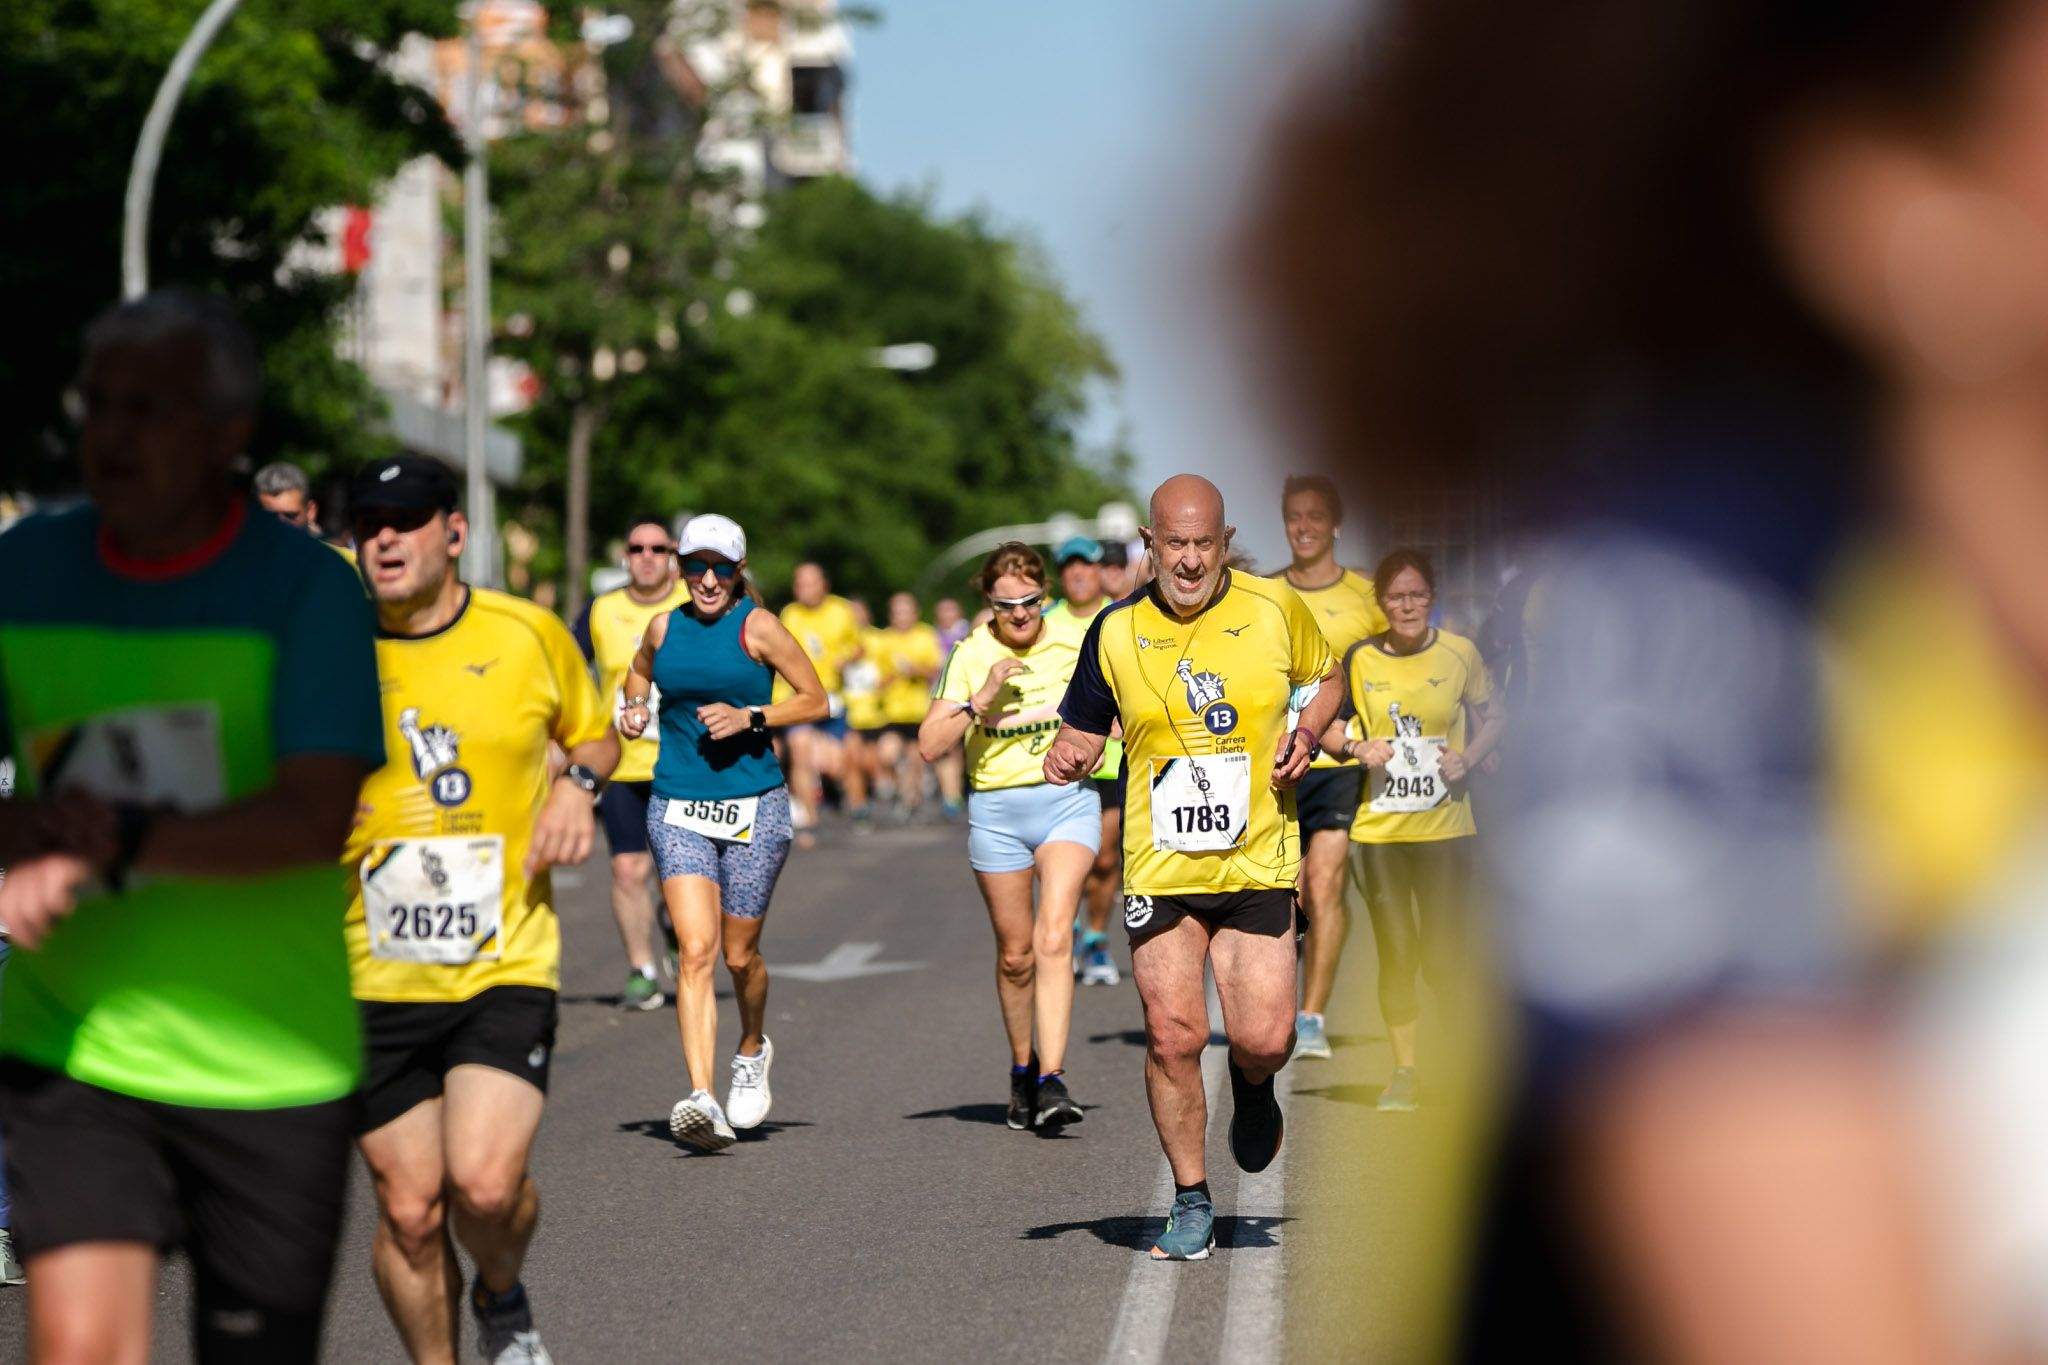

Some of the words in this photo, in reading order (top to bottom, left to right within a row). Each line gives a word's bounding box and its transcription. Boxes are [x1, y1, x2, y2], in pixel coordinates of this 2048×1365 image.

[1210, 710, 1232, 728] 13
[1215, 737, 1246, 746] Carrera
[1215, 745, 1246, 755] Liberty
[1384, 775, 1435, 798] 2943
[684, 800, 740, 825] 3556
[1171, 804, 1230, 834] 1783
[390, 904, 478, 940] 2625
